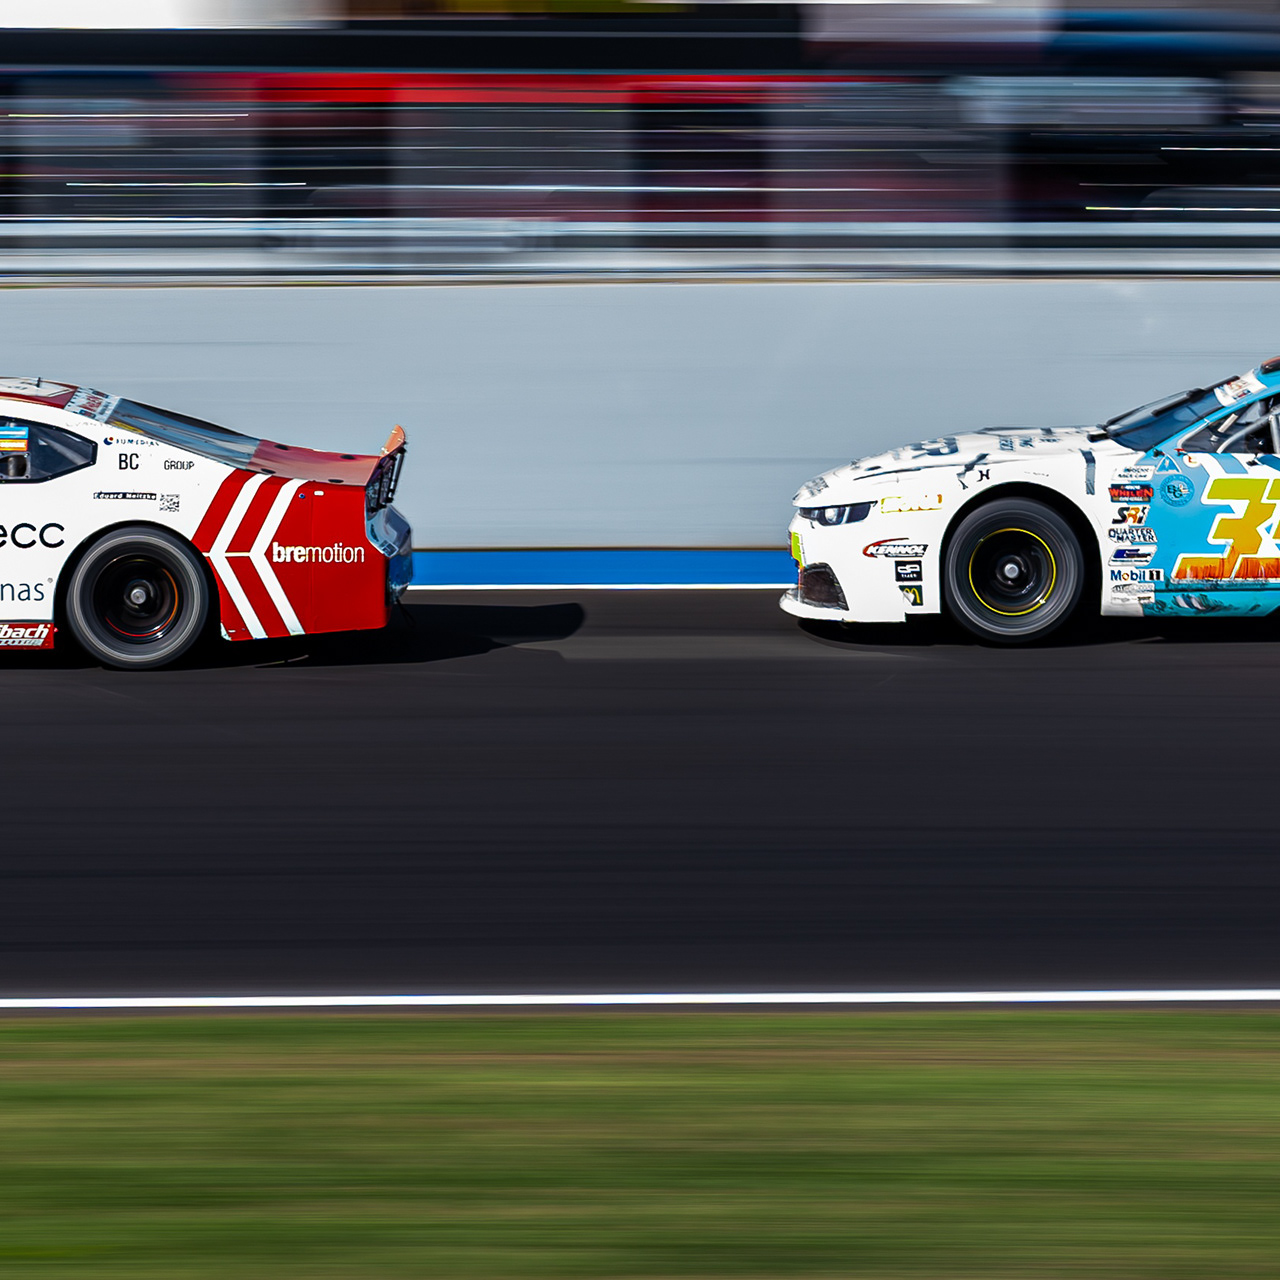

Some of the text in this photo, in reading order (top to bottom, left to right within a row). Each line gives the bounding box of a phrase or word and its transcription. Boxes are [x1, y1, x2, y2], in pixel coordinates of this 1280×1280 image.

[119, 453, 195, 471] BC GROUP
[272, 542, 365, 563] bremotion
[865, 544, 926, 555] KENNOL
[1111, 570, 1146, 581] Mobil
